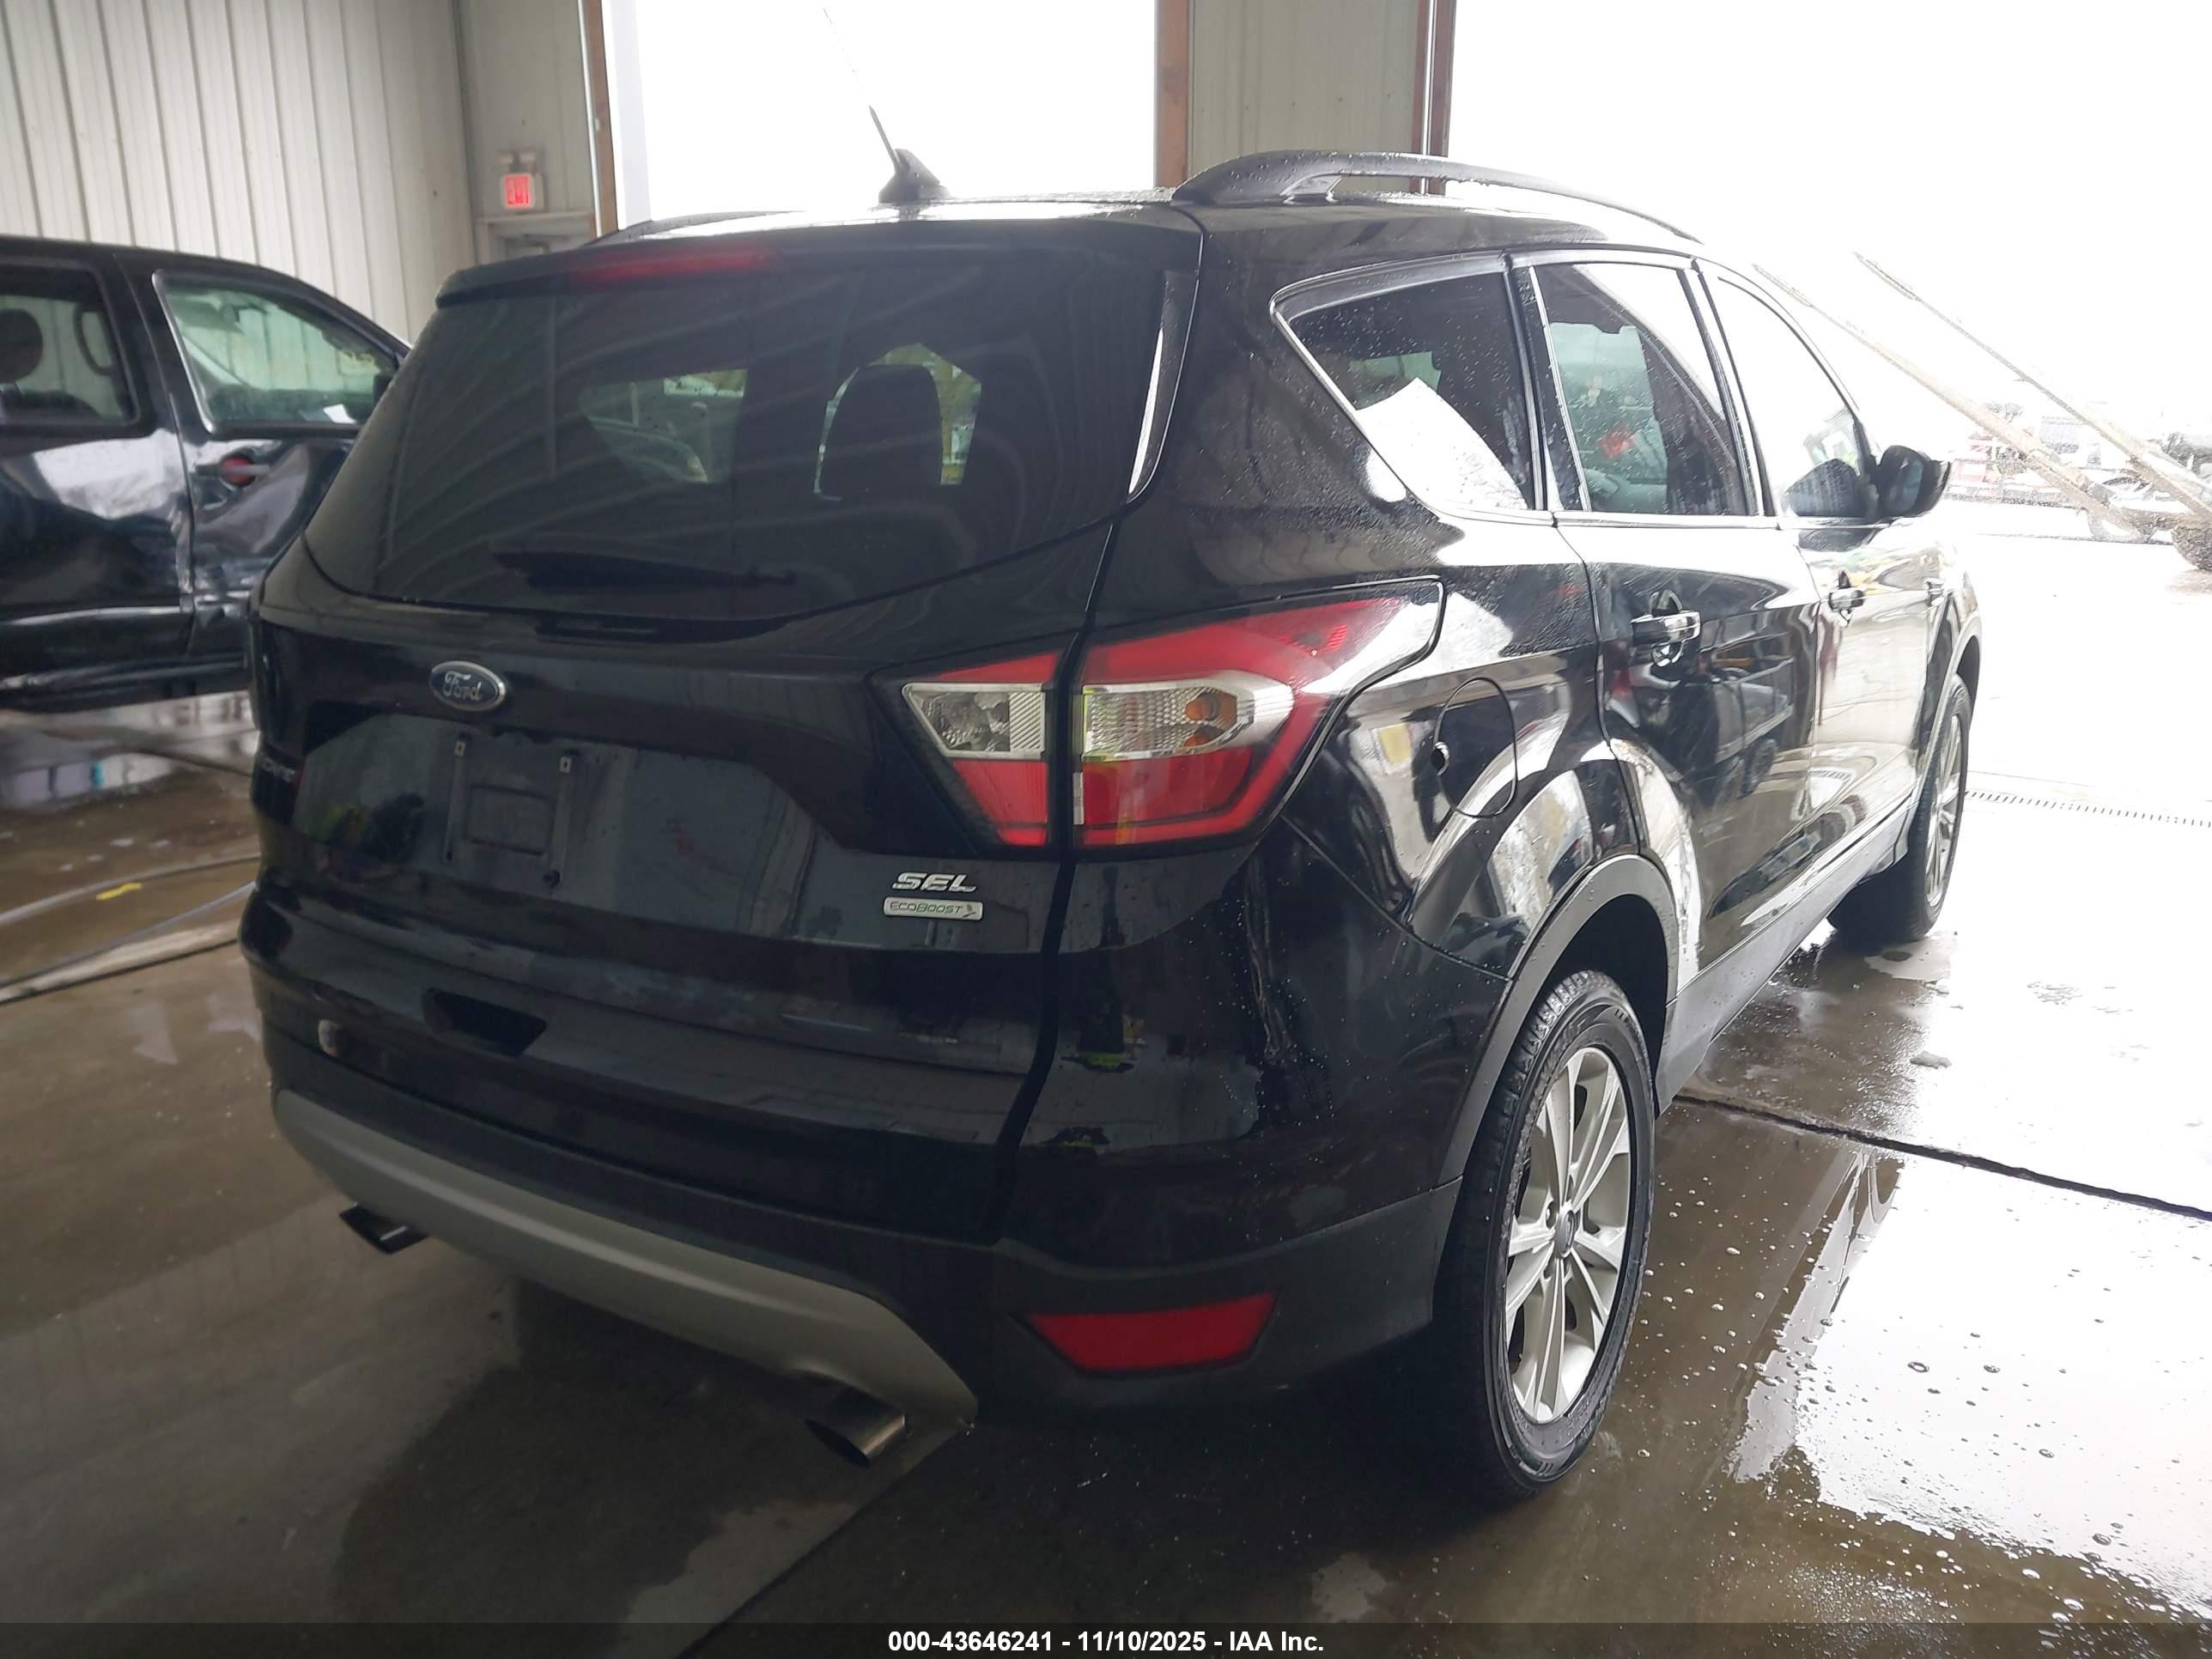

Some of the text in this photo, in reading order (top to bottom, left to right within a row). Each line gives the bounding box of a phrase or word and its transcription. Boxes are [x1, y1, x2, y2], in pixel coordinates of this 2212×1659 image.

[443, 671, 482, 701] Ford
[892, 872, 976, 891] SEL
[890, 902, 963, 914] ECOBOOST
